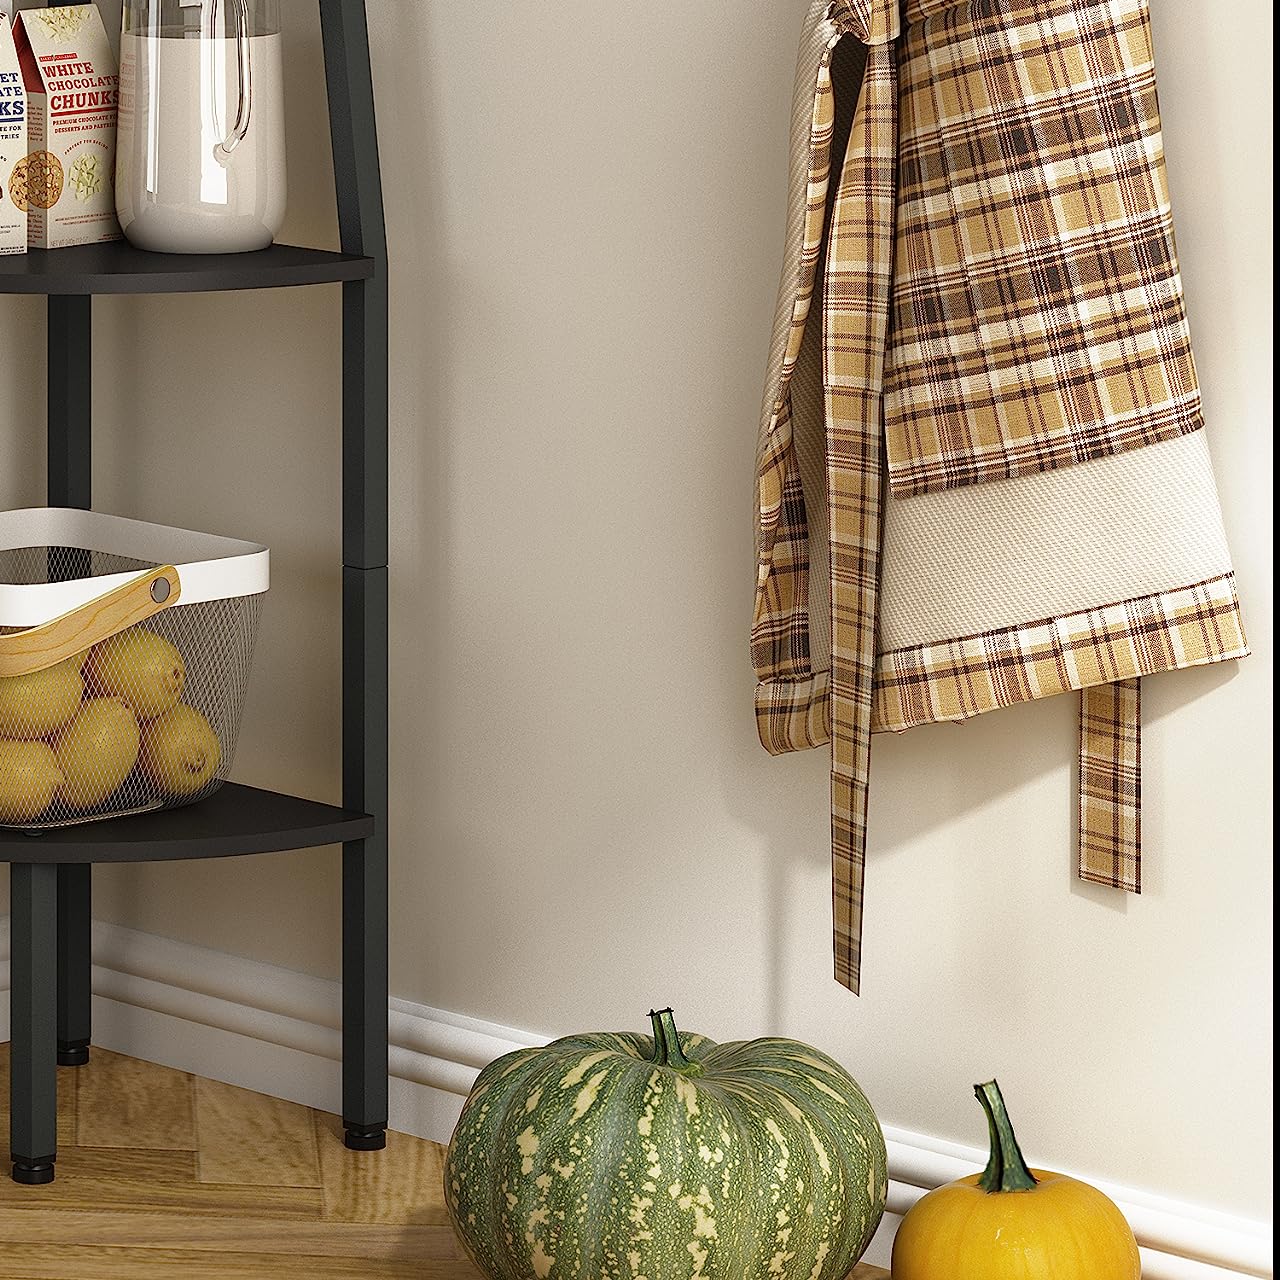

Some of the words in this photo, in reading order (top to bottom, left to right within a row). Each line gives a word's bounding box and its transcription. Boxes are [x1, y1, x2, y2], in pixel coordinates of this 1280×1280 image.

[42, 61, 95, 78] WHITE
[47, 75, 119, 91] CHOCOLATE
[50, 90, 119, 111] CHUNKS
[52, 118, 78, 126] PREMIUM
[78, 115, 108, 123] CHOCOLATE
[54, 126, 81, 134] DESSERTS
